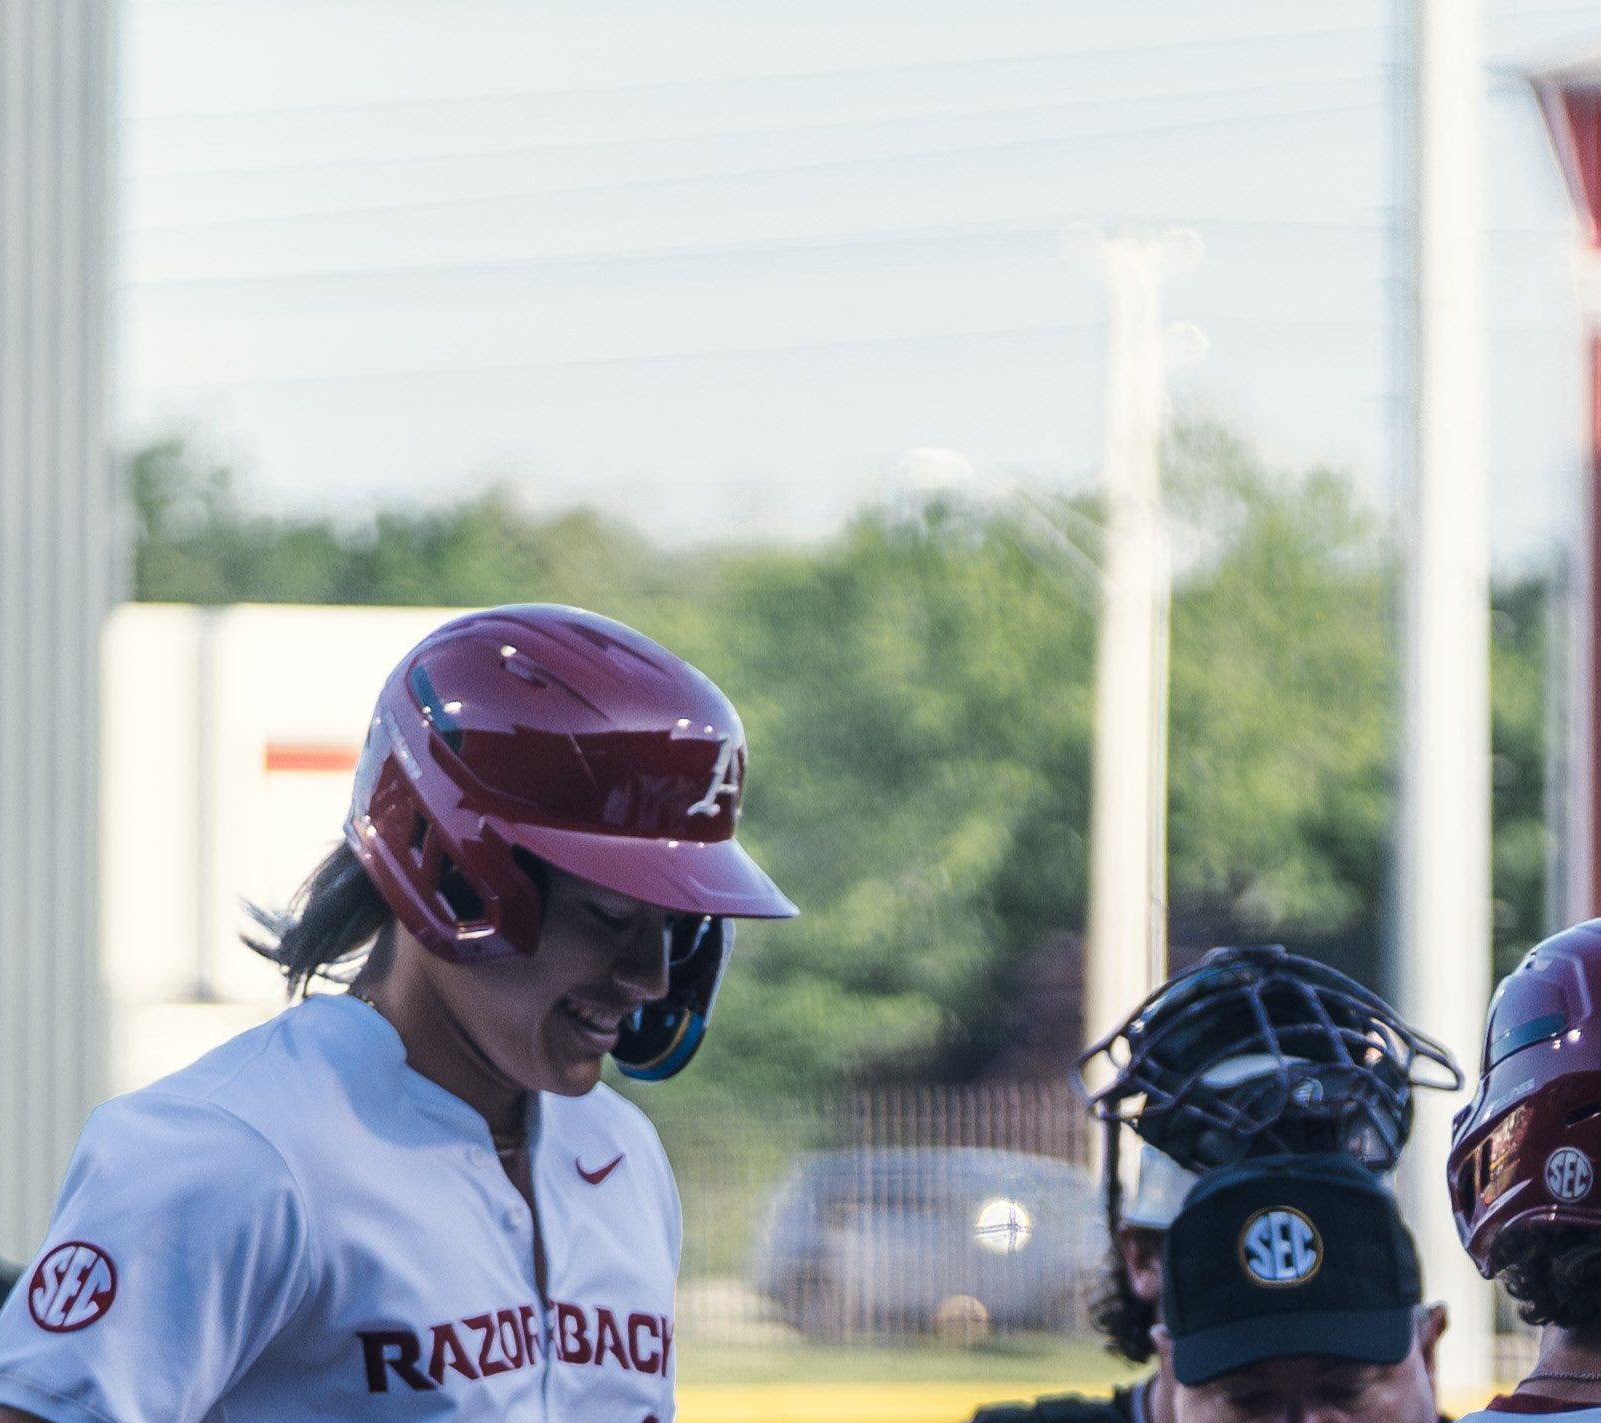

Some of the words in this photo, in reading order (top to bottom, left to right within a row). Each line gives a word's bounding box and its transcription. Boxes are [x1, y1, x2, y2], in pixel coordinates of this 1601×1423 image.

[1546, 1148, 1593, 1200] SEC
[1242, 1209, 1320, 1283] SEC
[29, 1243, 115, 1329] SEC
